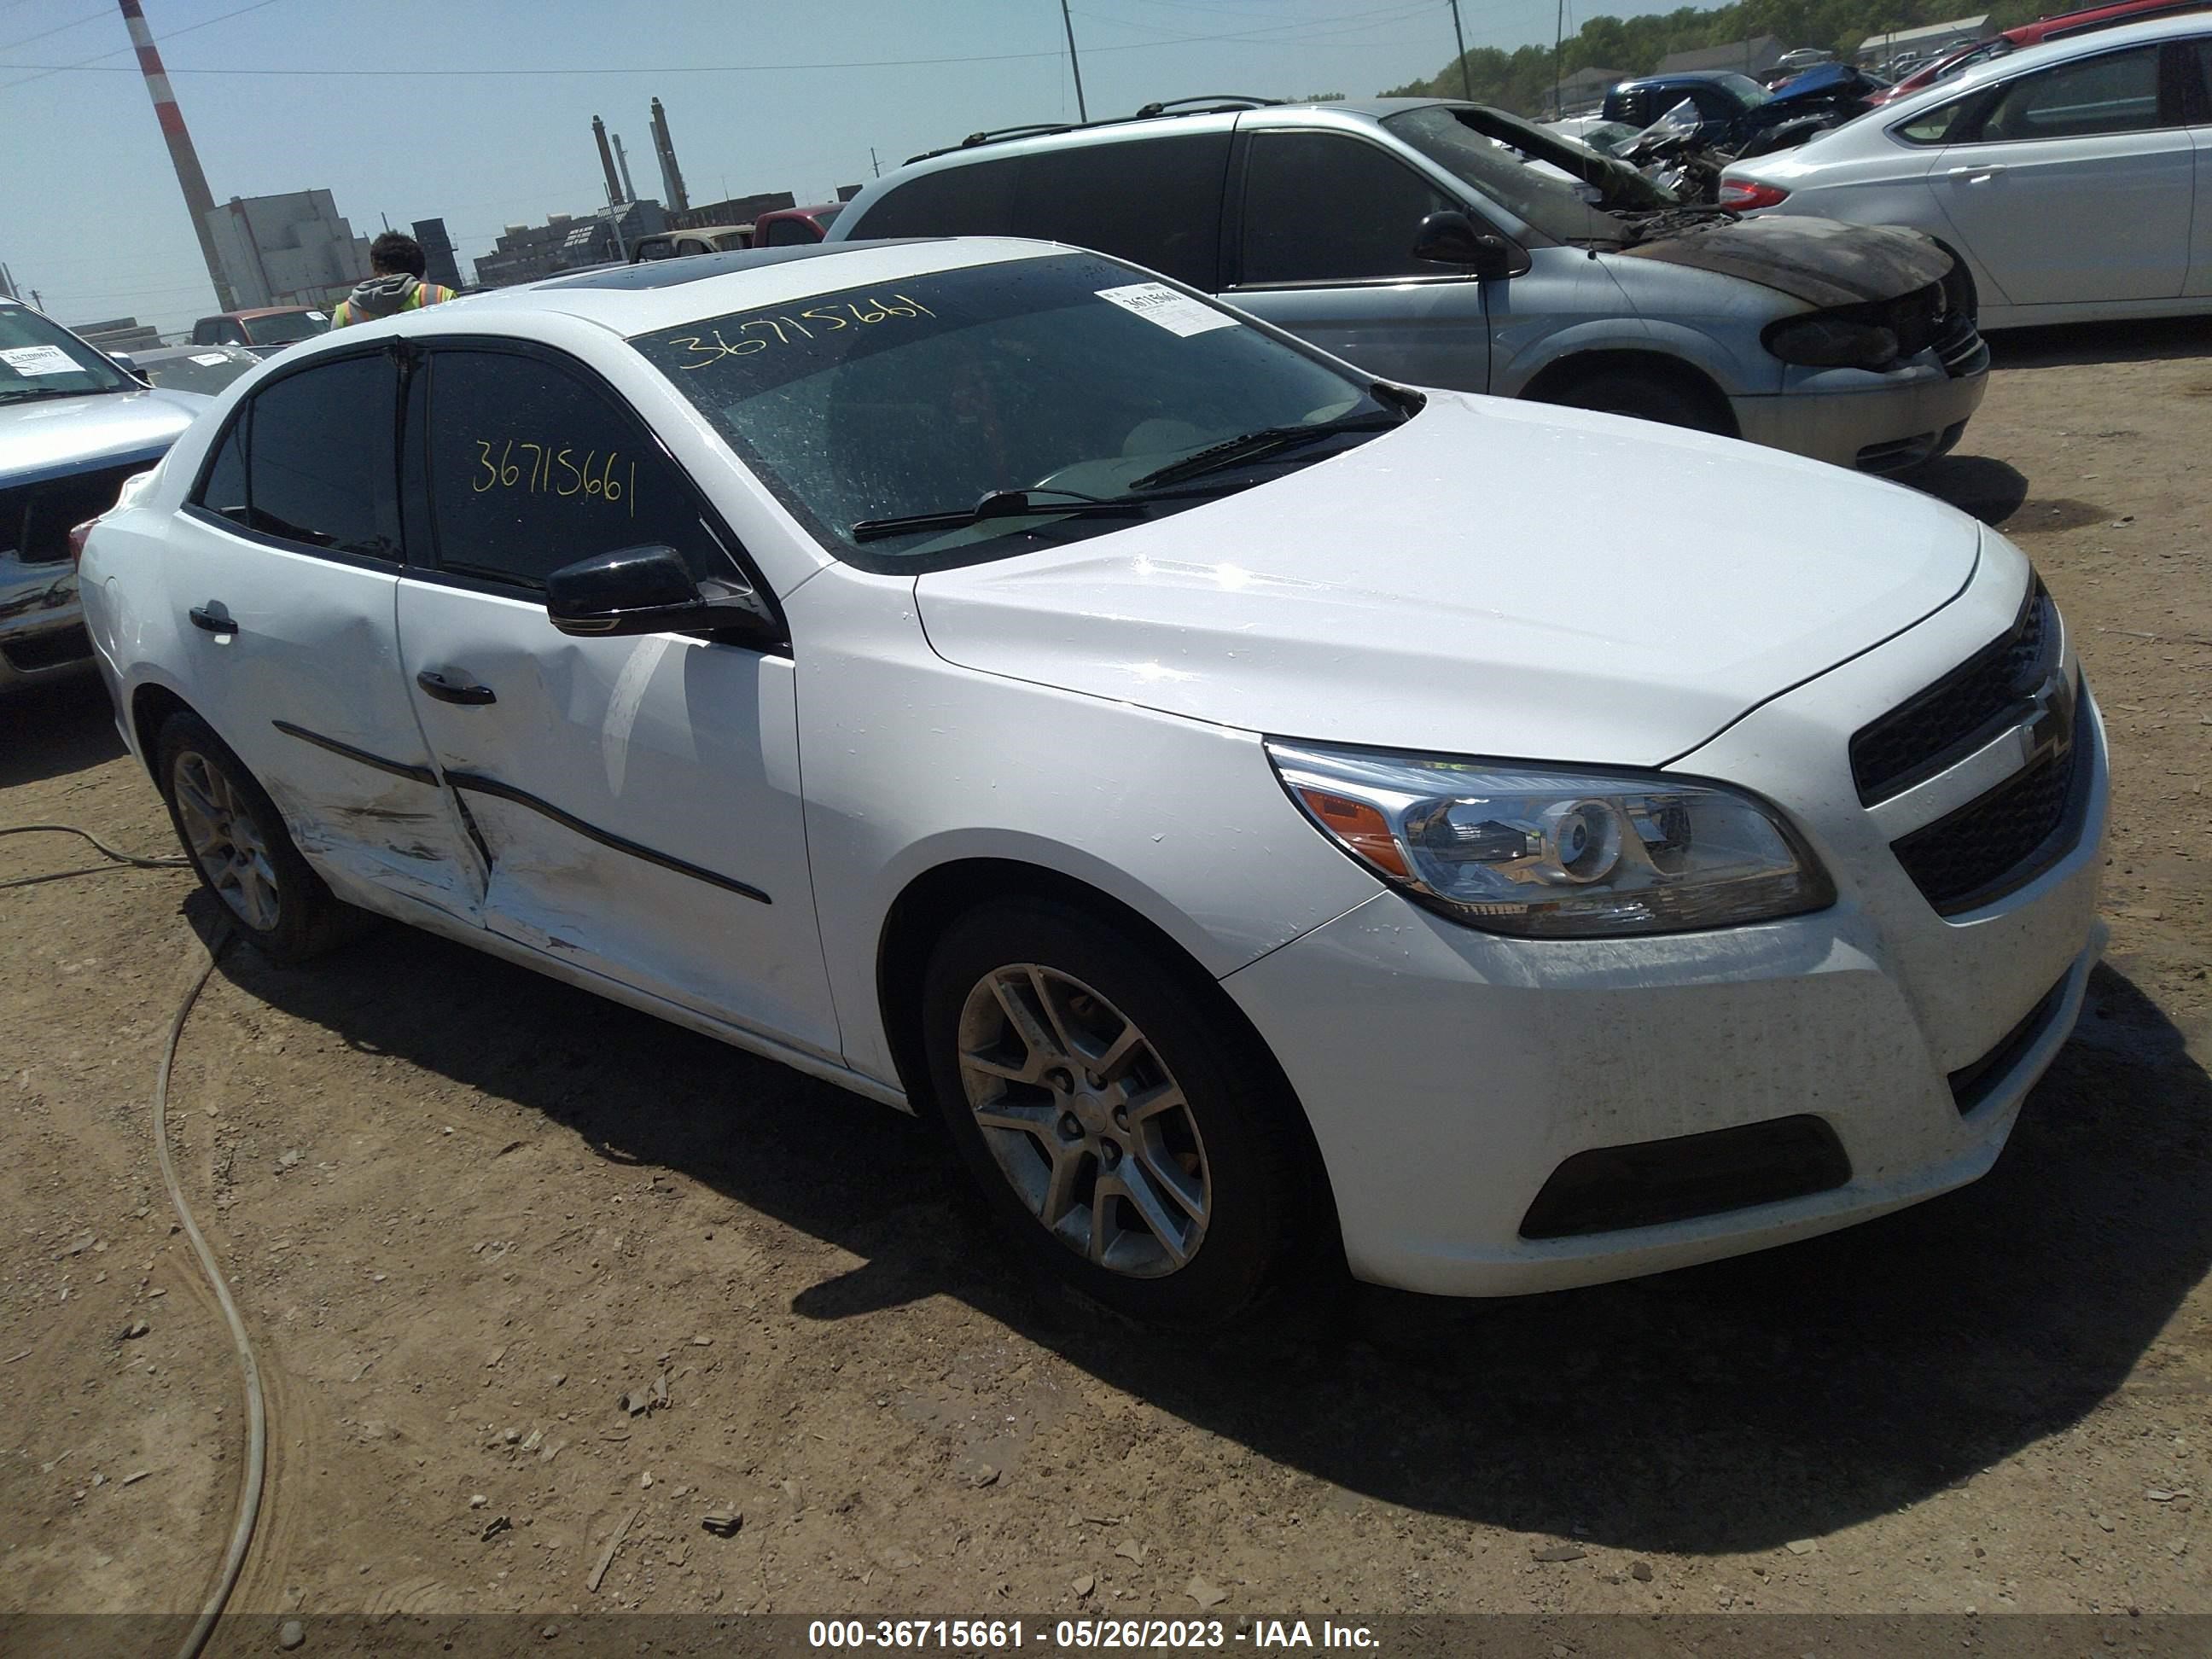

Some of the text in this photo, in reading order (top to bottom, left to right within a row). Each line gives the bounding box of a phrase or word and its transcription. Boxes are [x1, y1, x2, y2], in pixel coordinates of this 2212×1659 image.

[668, 294, 937, 370] 36715661
[1122, 291, 1183, 309] 36715661
[473, 439, 635, 518] 36715661
